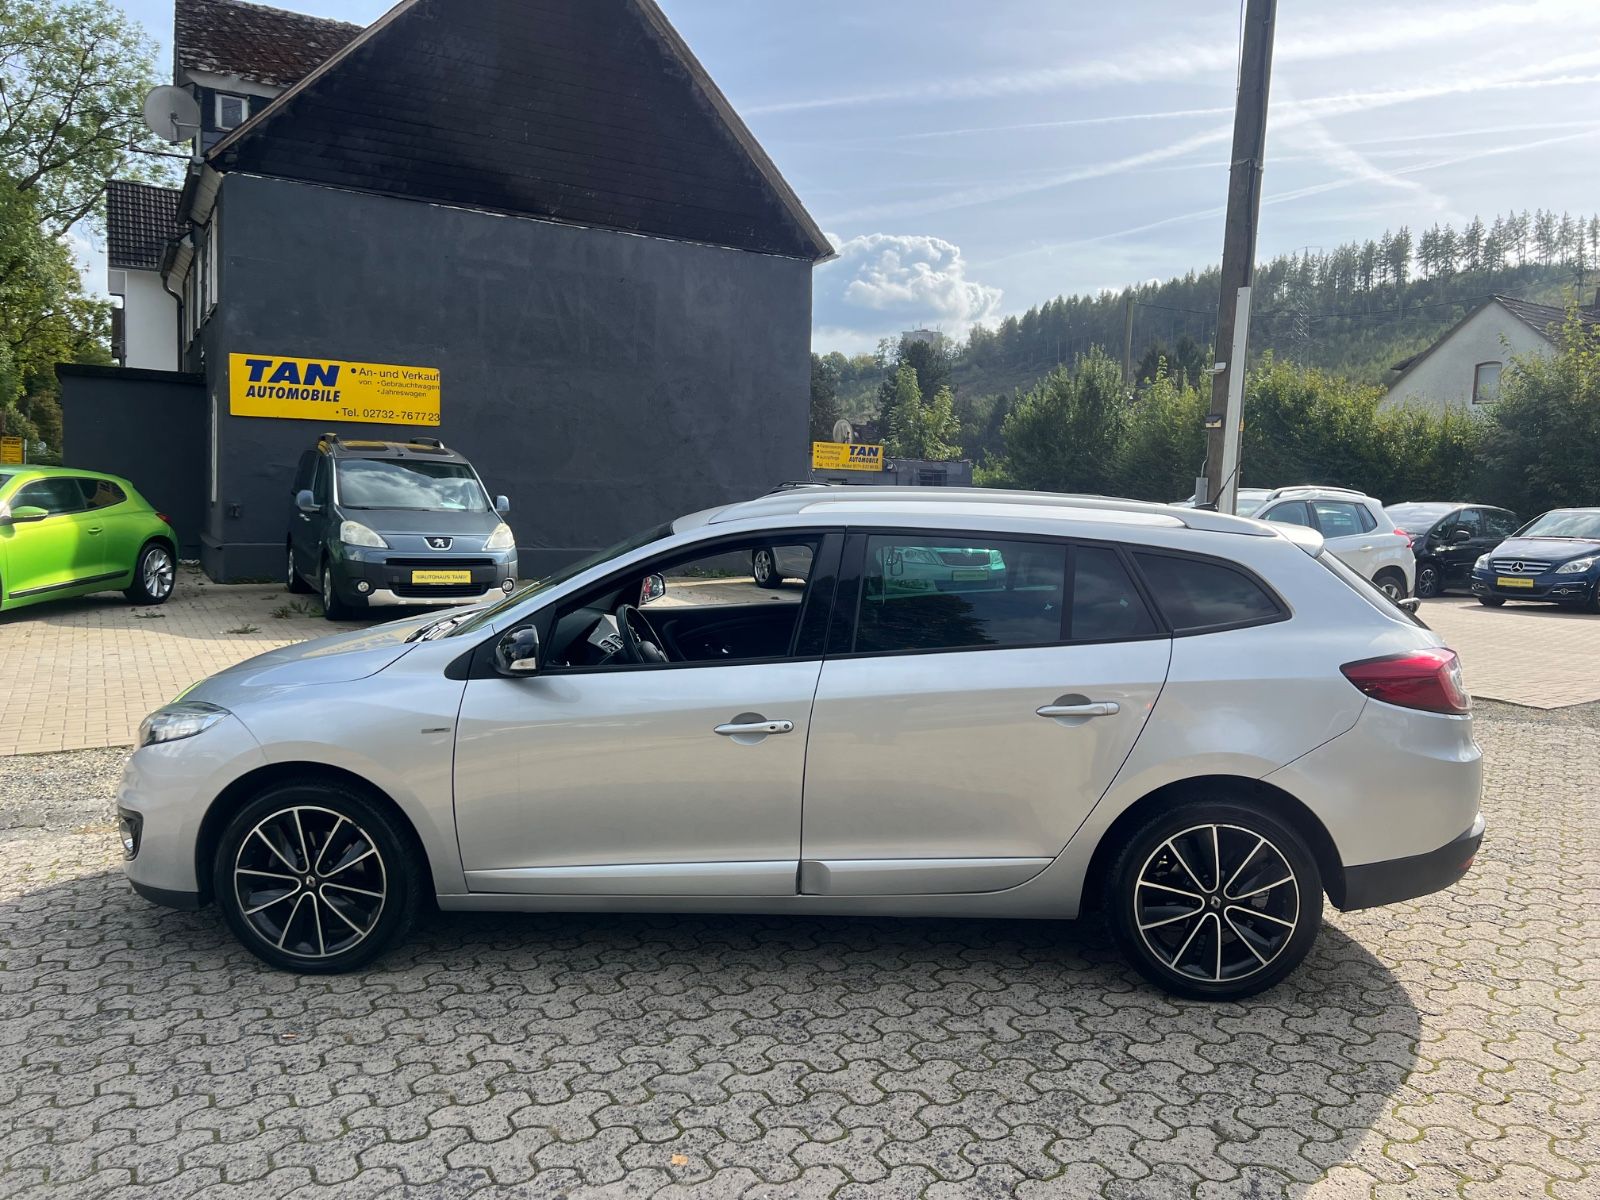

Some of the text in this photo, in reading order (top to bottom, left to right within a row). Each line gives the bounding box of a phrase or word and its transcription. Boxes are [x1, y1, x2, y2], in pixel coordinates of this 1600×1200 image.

[245, 358, 340, 387] TAN
[359, 367, 440, 382] An- und Verkauf
[380, 379, 440, 391] Gebrauchtwagen
[245, 385, 341, 403] AUTOMOBILE
[380, 388, 427, 398] Jahreswagen
[341, 407, 359, 417] Tel.
[849, 445, 879, 457] TAN
